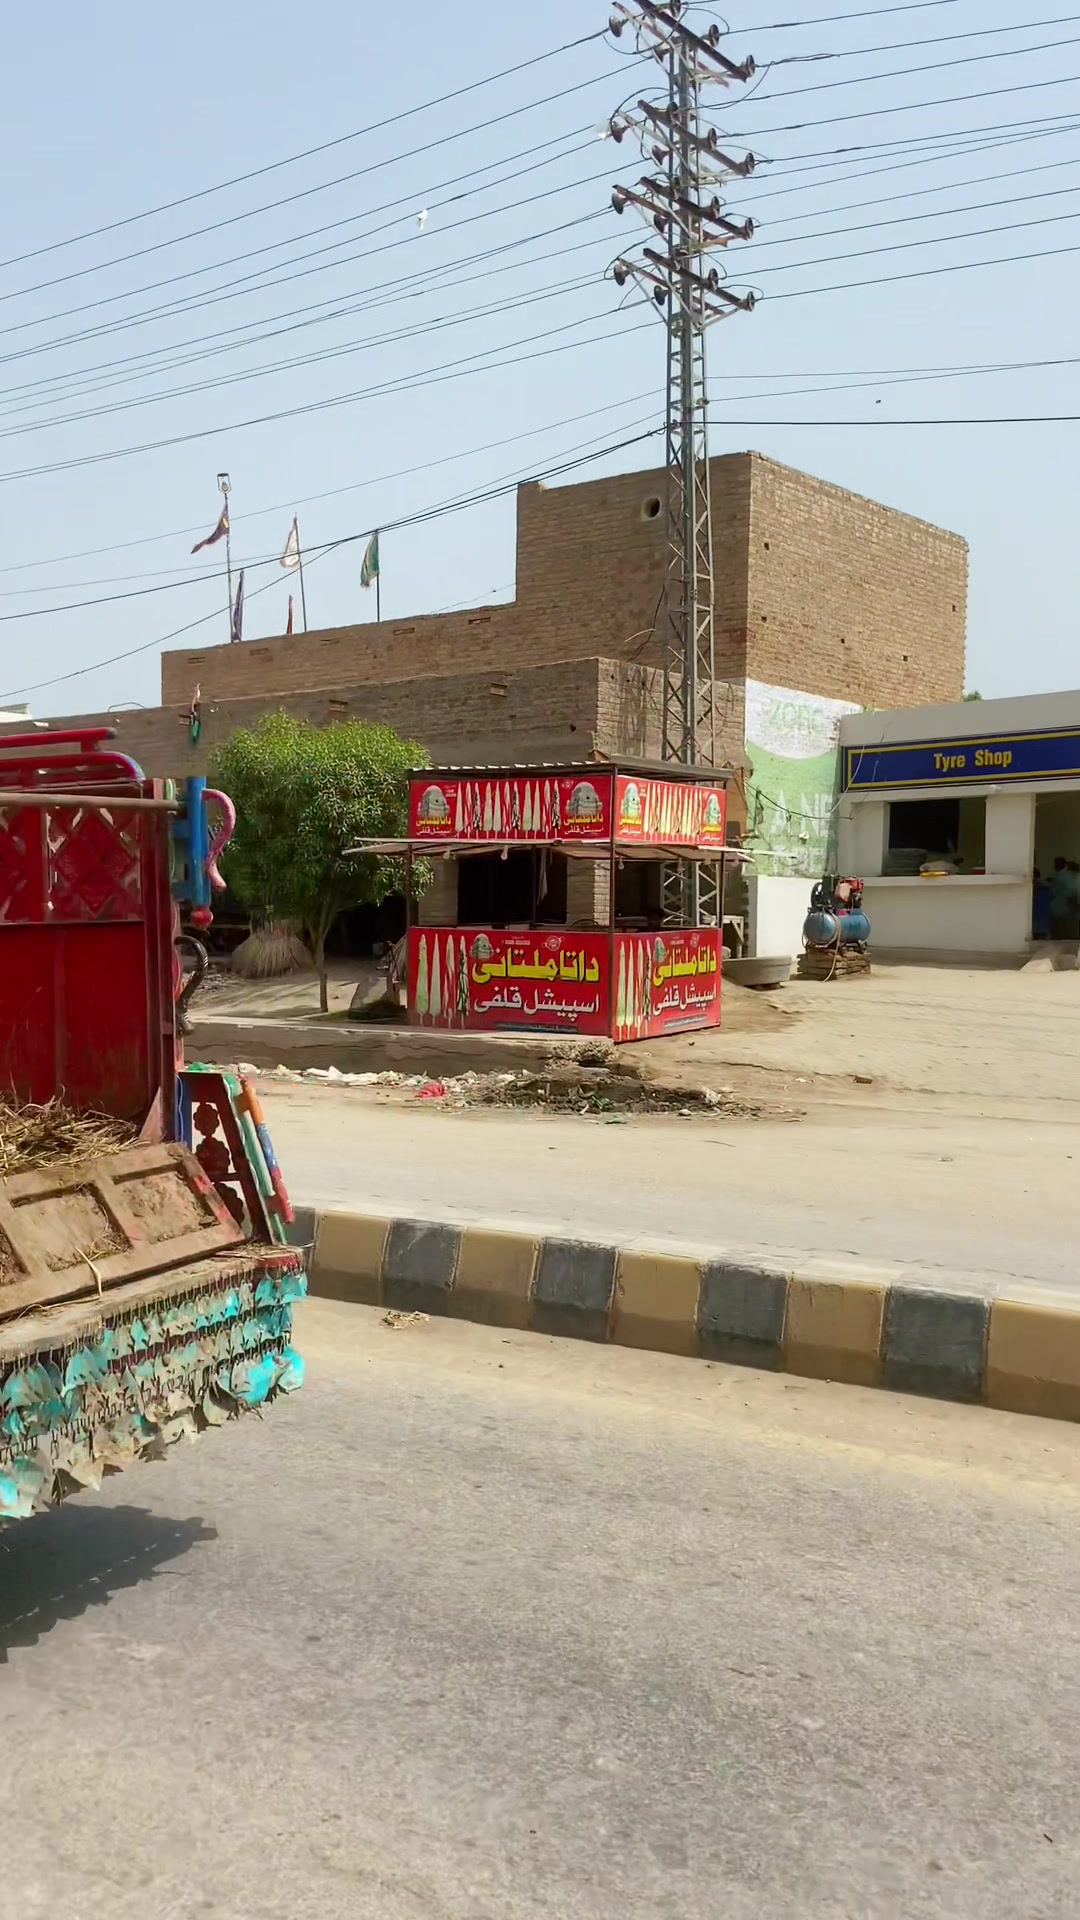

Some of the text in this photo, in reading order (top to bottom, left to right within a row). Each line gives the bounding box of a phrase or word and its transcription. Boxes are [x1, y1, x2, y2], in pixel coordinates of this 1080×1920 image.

[933, 749, 1013, 772] Tyre Shop
[472, 947, 600, 984] داتا ملتانی
[653, 944, 717, 986] داتا ملتانی
[473, 986, 599, 1022] اسپیشل قلفی
[653, 984, 680, 1016] قلفی
